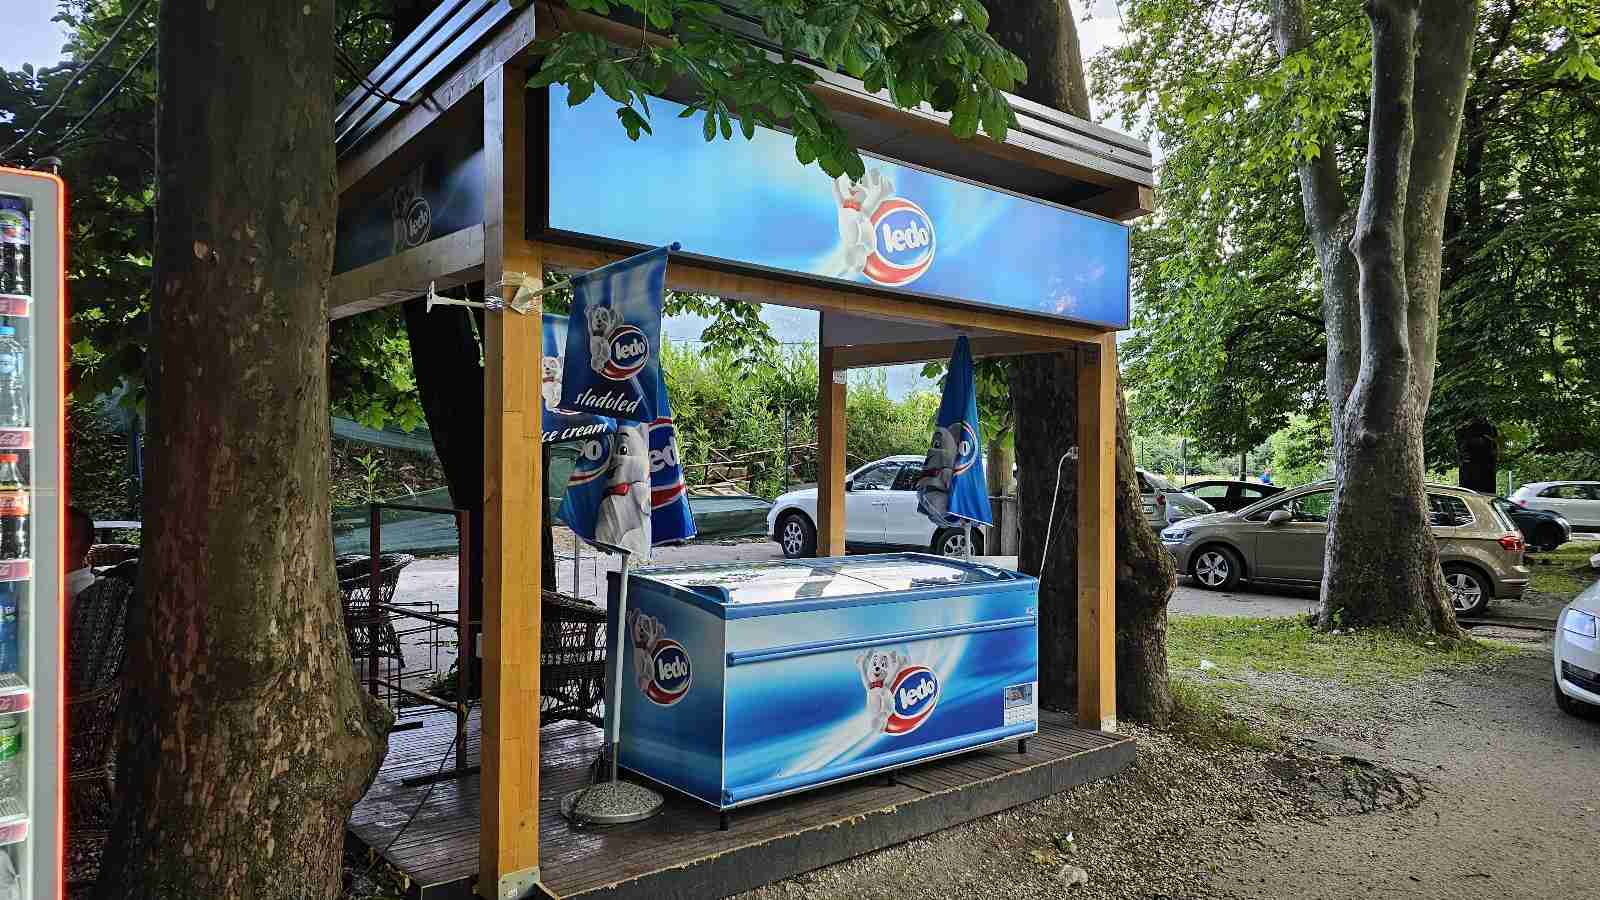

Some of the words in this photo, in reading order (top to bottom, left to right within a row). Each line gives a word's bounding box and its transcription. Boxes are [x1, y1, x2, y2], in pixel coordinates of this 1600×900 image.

[408, 209, 428, 237] ledo
[882, 219, 929, 253] ledo
[615, 338, 645, 360] ledo
[573, 388, 643, 413] sladoled
[541, 430, 557, 441] ce
[561, 422, 608, 439] cream
[658, 656, 688, 680] ledo
[900, 678, 935, 709] ledo
